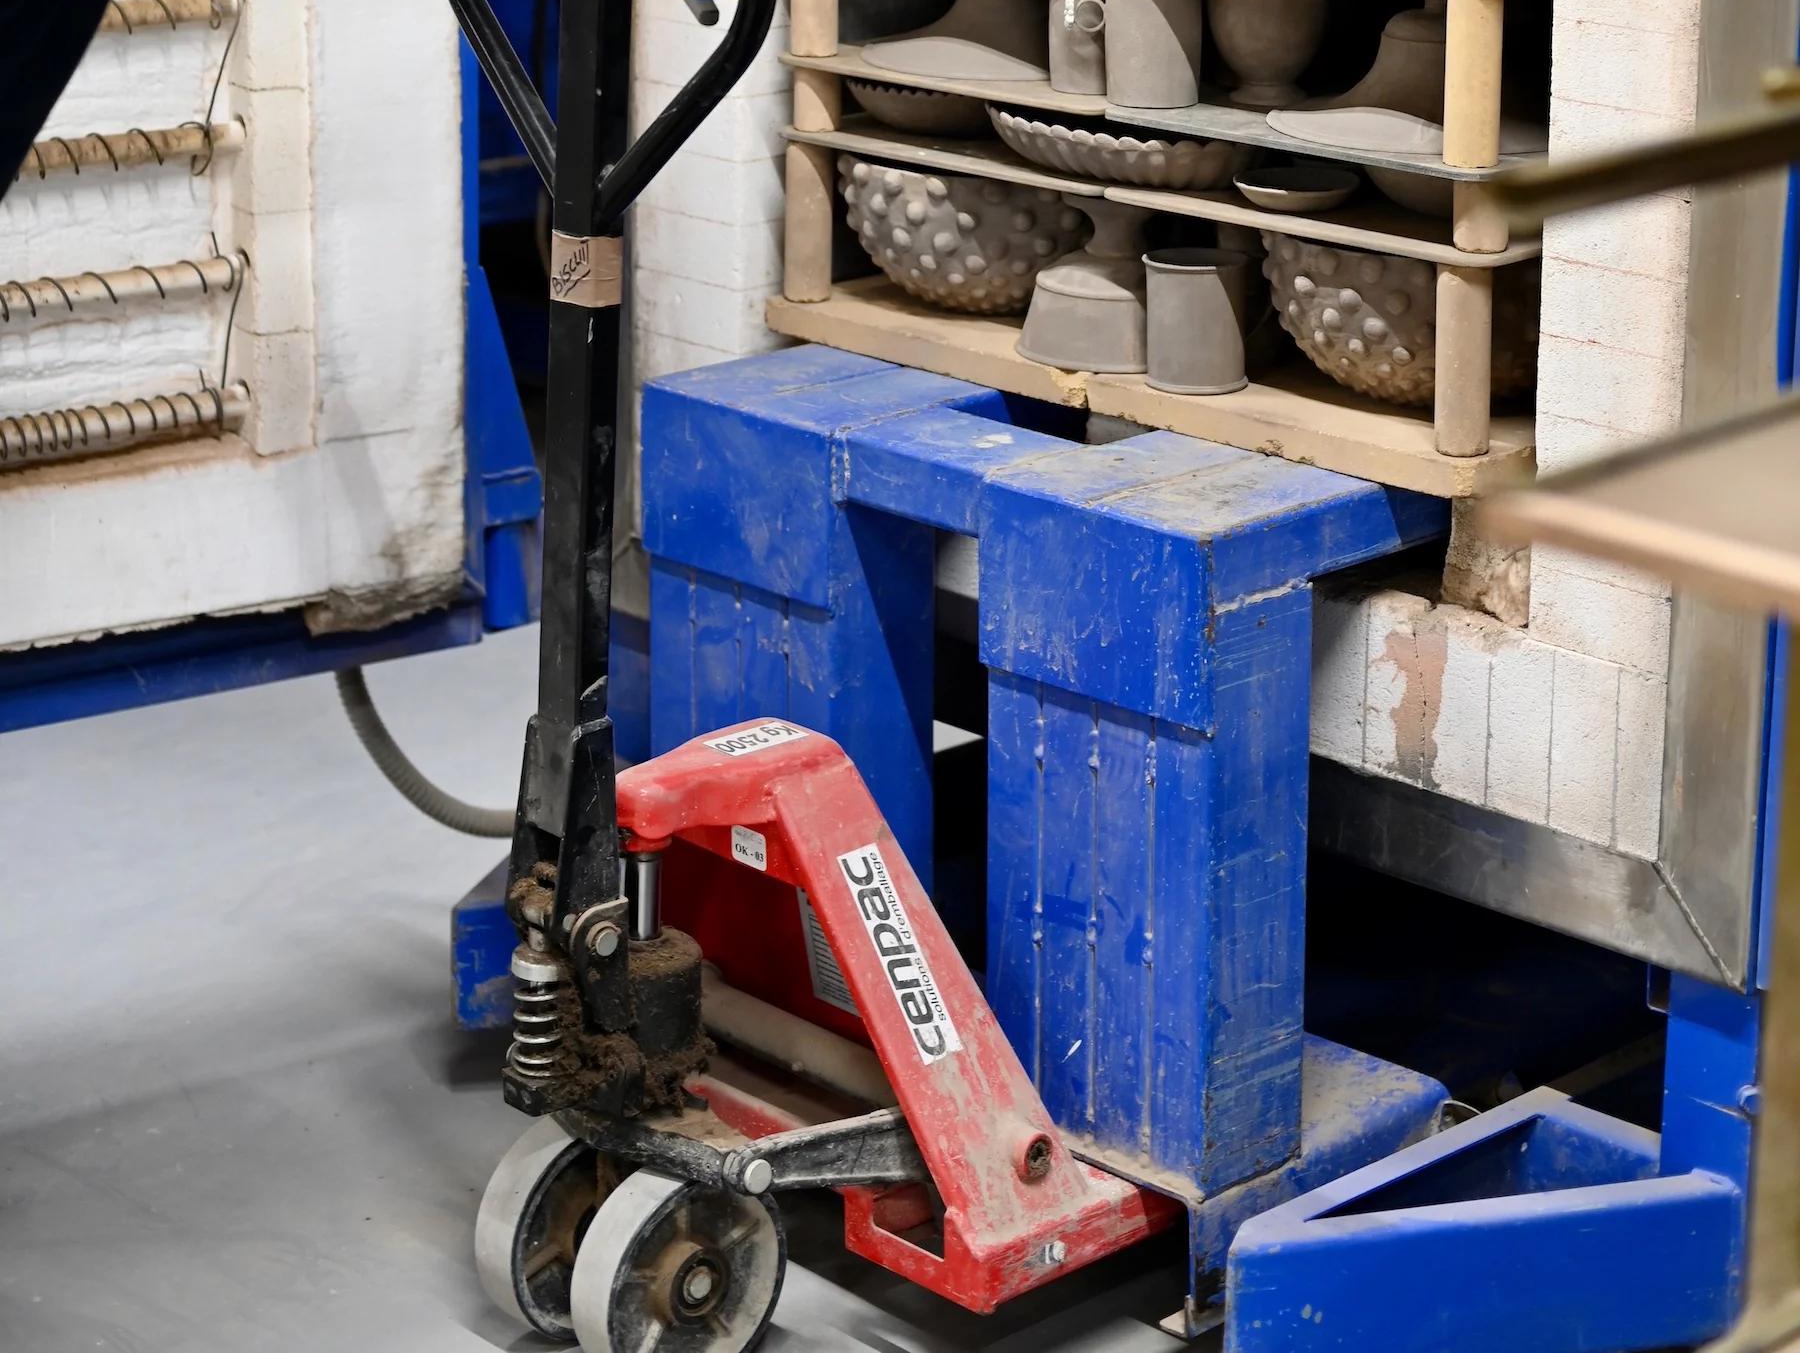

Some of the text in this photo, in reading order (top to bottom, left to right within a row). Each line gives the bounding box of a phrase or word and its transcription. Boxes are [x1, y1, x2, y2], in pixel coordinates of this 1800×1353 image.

[714, 725, 799, 753] Kg 2500
[735, 843, 748, 856] OK
[841, 856, 946, 1056] cenpac
[869, 852, 947, 1021] solutions d'emballage
